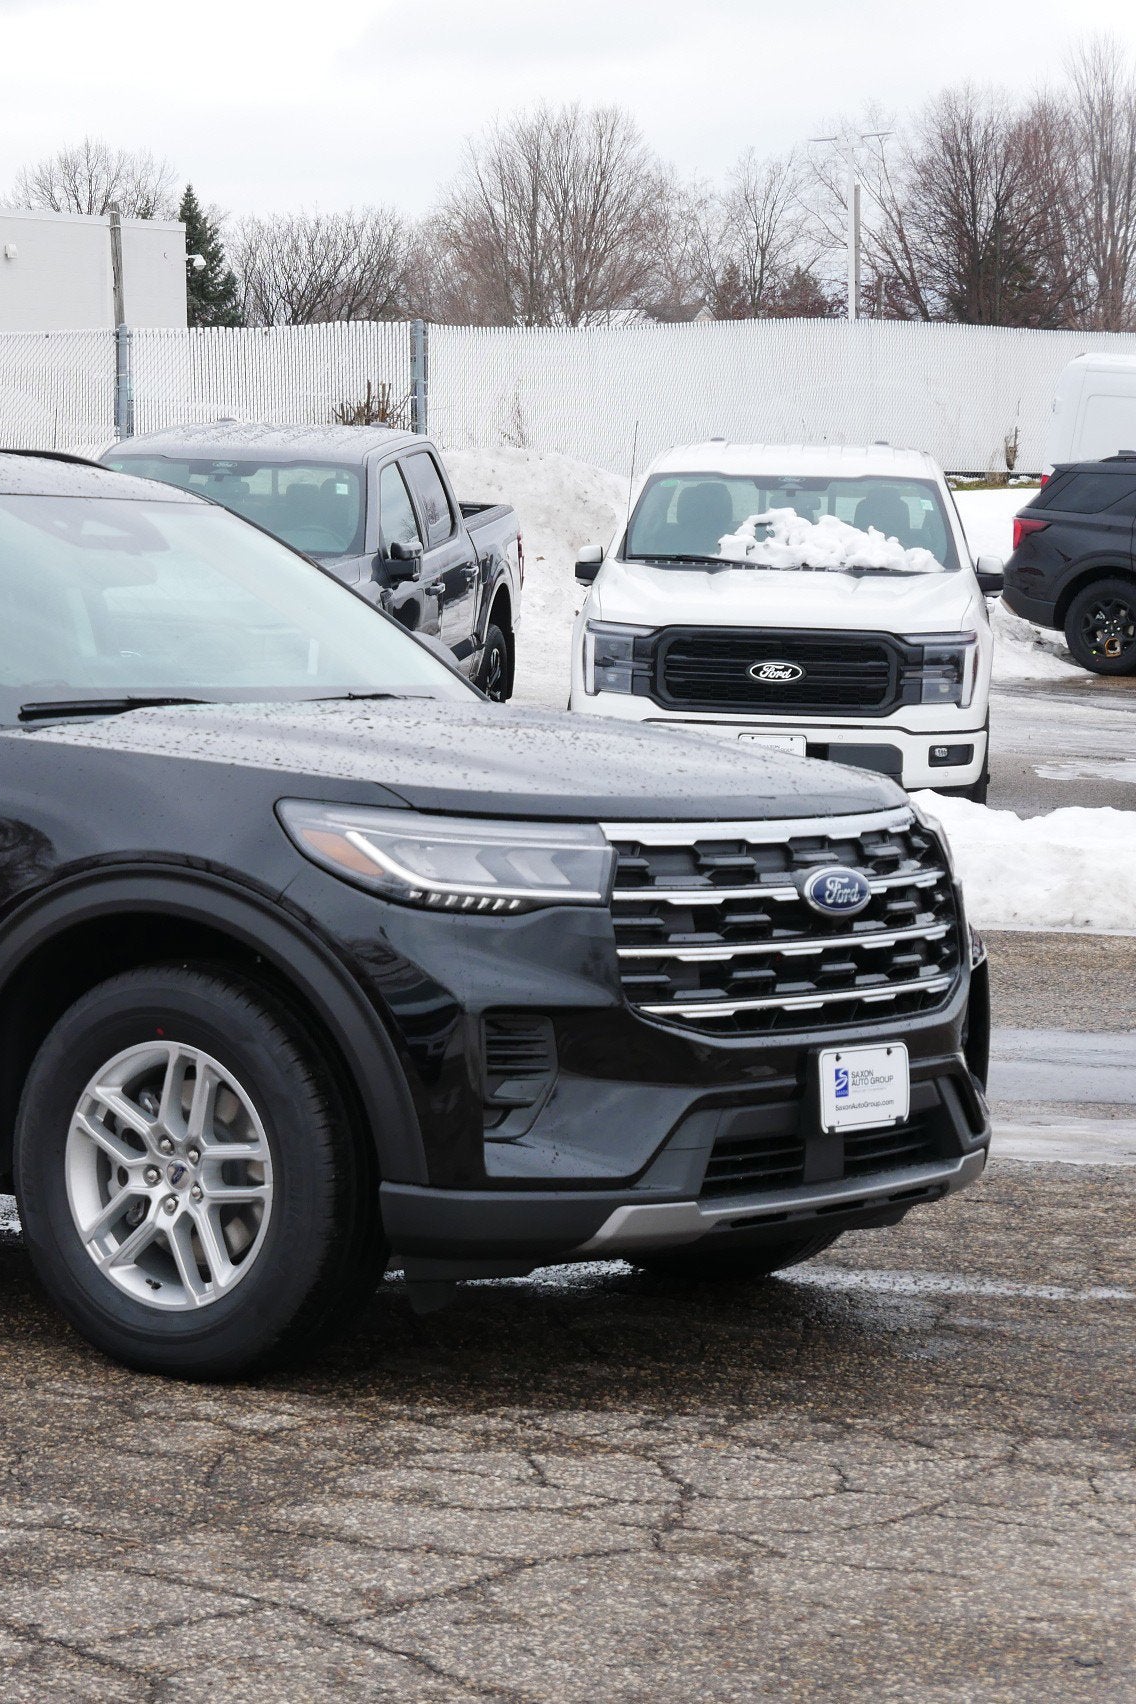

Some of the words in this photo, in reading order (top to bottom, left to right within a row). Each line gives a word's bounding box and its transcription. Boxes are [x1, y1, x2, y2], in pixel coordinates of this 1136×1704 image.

[759, 664, 793, 679] Ford
[825, 876, 860, 904] Ford
[851, 1070, 873, 1078] SAXON
[852, 1077, 869, 1086] AUTO
[870, 1075, 893, 1084] GROUP
[835, 1100, 895, 1111] SaxonAutoGroup.com
